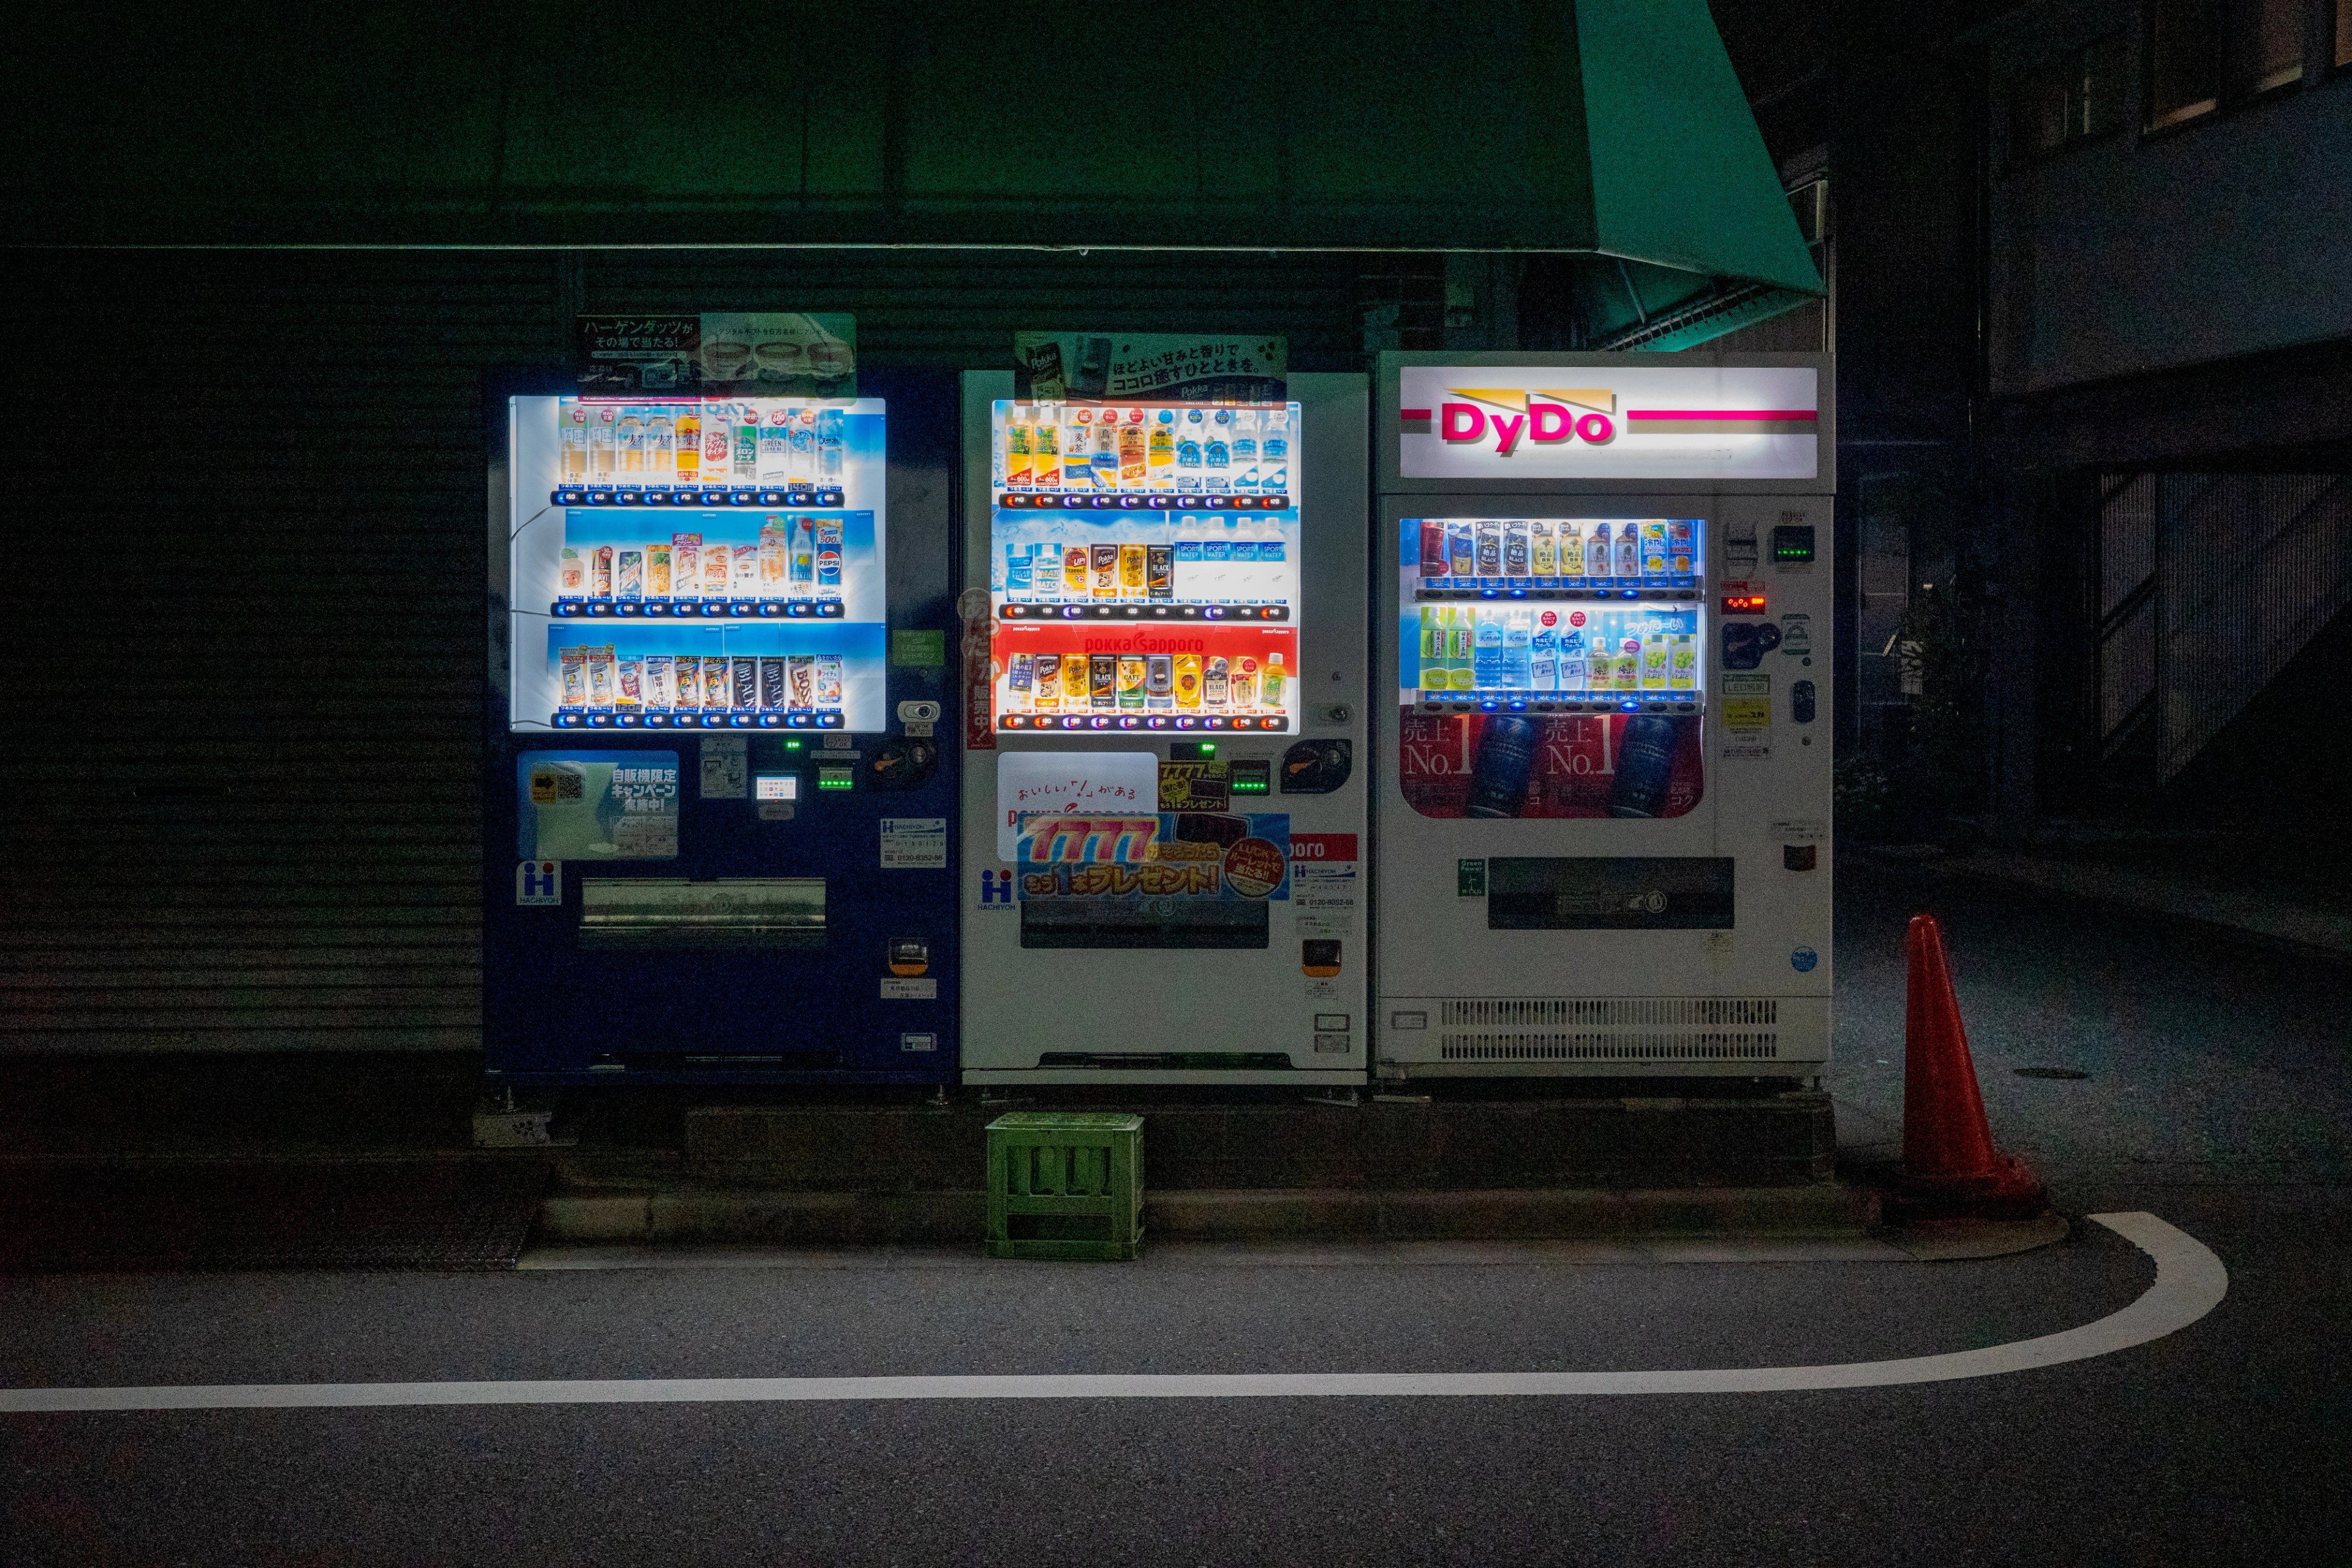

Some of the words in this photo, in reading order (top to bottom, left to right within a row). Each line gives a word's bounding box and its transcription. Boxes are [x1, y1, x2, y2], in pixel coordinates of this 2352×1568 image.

[1113, 344, 1239, 375] ほどよい甘みと香りで
[1180, 383, 1208, 399] Pokka
[1441, 402, 1614, 453] DyDo
[1074, 433, 1084, 453] 麦茶
[1101, 429, 1110, 451] 烏龍
[1098, 554, 1114, 563] Pokka
[1126, 556, 1142, 564] Pokka
[1483, 548, 1496, 557] 絶品
[1510, 548, 1524, 557] 絶品
[1624, 618, 1684, 636] つめた～い
[1085, 638, 1131, 653] pokka
[1139, 638, 1204, 654] sapporo
[1039, 664, 1055, 674] Pokka
[1068, 665, 1085, 674] Pokka
[737, 666, 755, 707] BLACK
[766, 668, 785, 707] BLACK
[796, 669, 813, 706] BOSS
[1404, 718, 1450, 743] 売上
[1547, 718, 1592, 743] 売上
[612, 768, 677, 783] 自販機限定
[1160, 764, 1205, 778] 7777
[611, 784, 676, 798] キャンペーン
[1027, 819, 1158, 862] 7777
